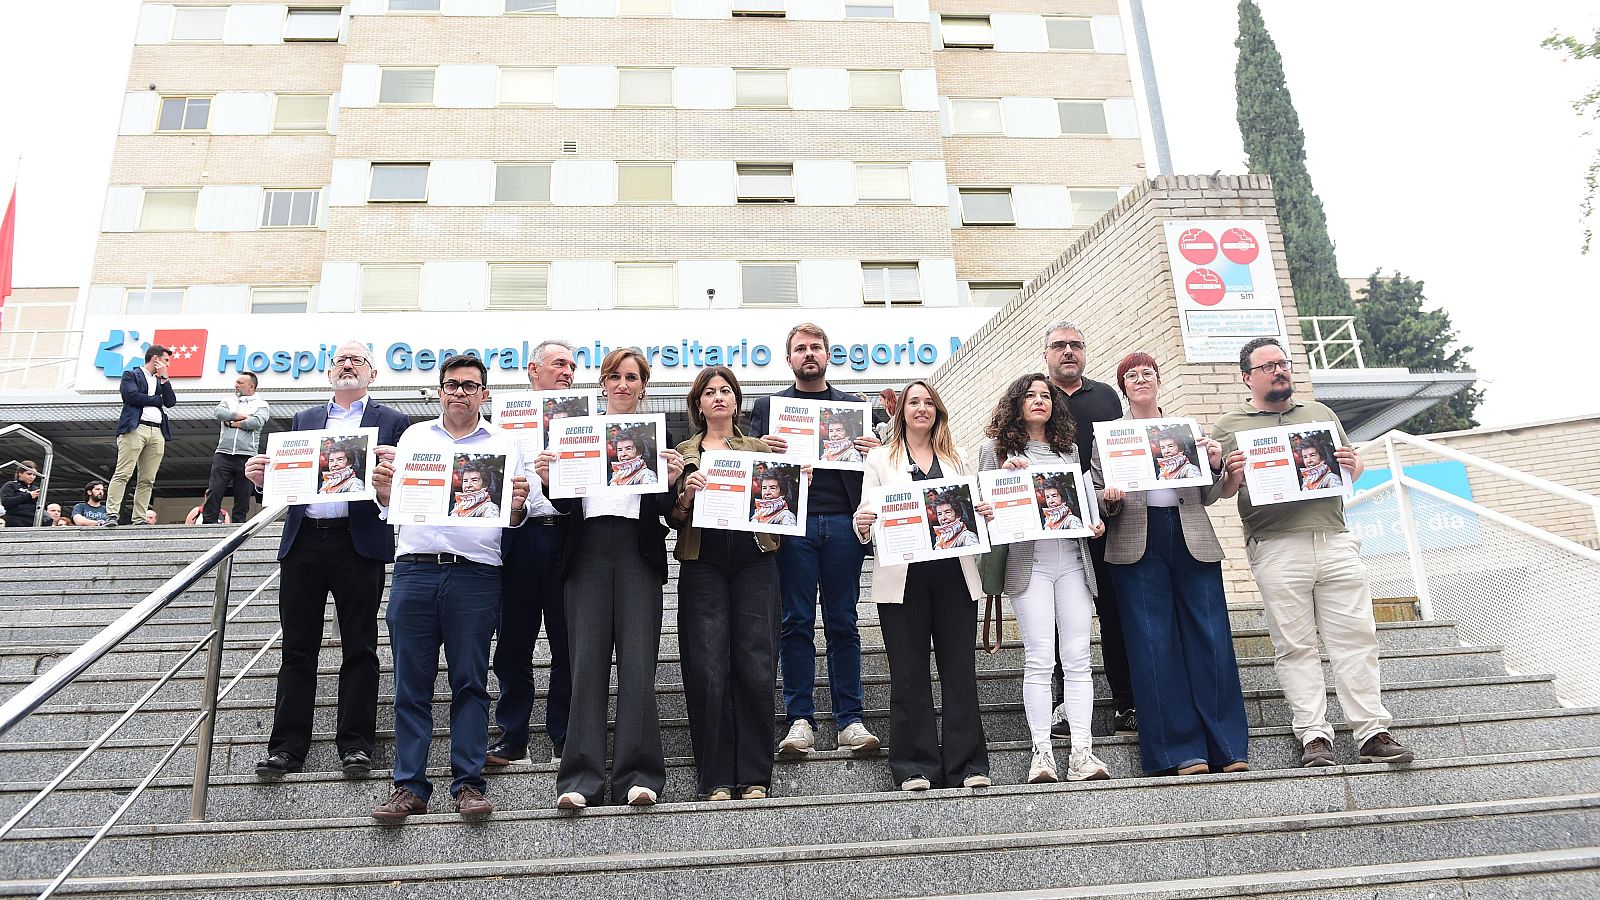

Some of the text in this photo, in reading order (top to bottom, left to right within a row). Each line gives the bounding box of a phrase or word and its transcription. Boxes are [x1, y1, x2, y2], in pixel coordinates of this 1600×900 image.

[506, 400, 532, 409] DECRETO
[784, 405, 809, 414] DECRETO
[500, 408, 537, 418] MARICARMEN
[565, 426, 593, 435] DECRETO
[1110, 428, 1135, 437] DECRETO
[282, 439, 309, 448] DECRETO
[559, 435, 600, 445] MARICARMEN
[1106, 436, 1143, 446] MARICARMEN
[1253, 437, 1278, 447] DECRETO
[275, 448, 314, 457] MARICARMEN
[1250, 445, 1286, 456] MARICARMEN
[412, 453, 441, 462] DECRETO
[404, 463, 447, 473] MARICARMEN
[713, 459, 741, 468] DECRETO
[707, 468, 747, 479] MARICARMEN
[995, 476, 1021, 487] DECRETO
[991, 485, 1029, 497] MARICARMEN
[885, 492, 912, 503] DECRETO
[881, 501, 919, 514] MARICARMEN
